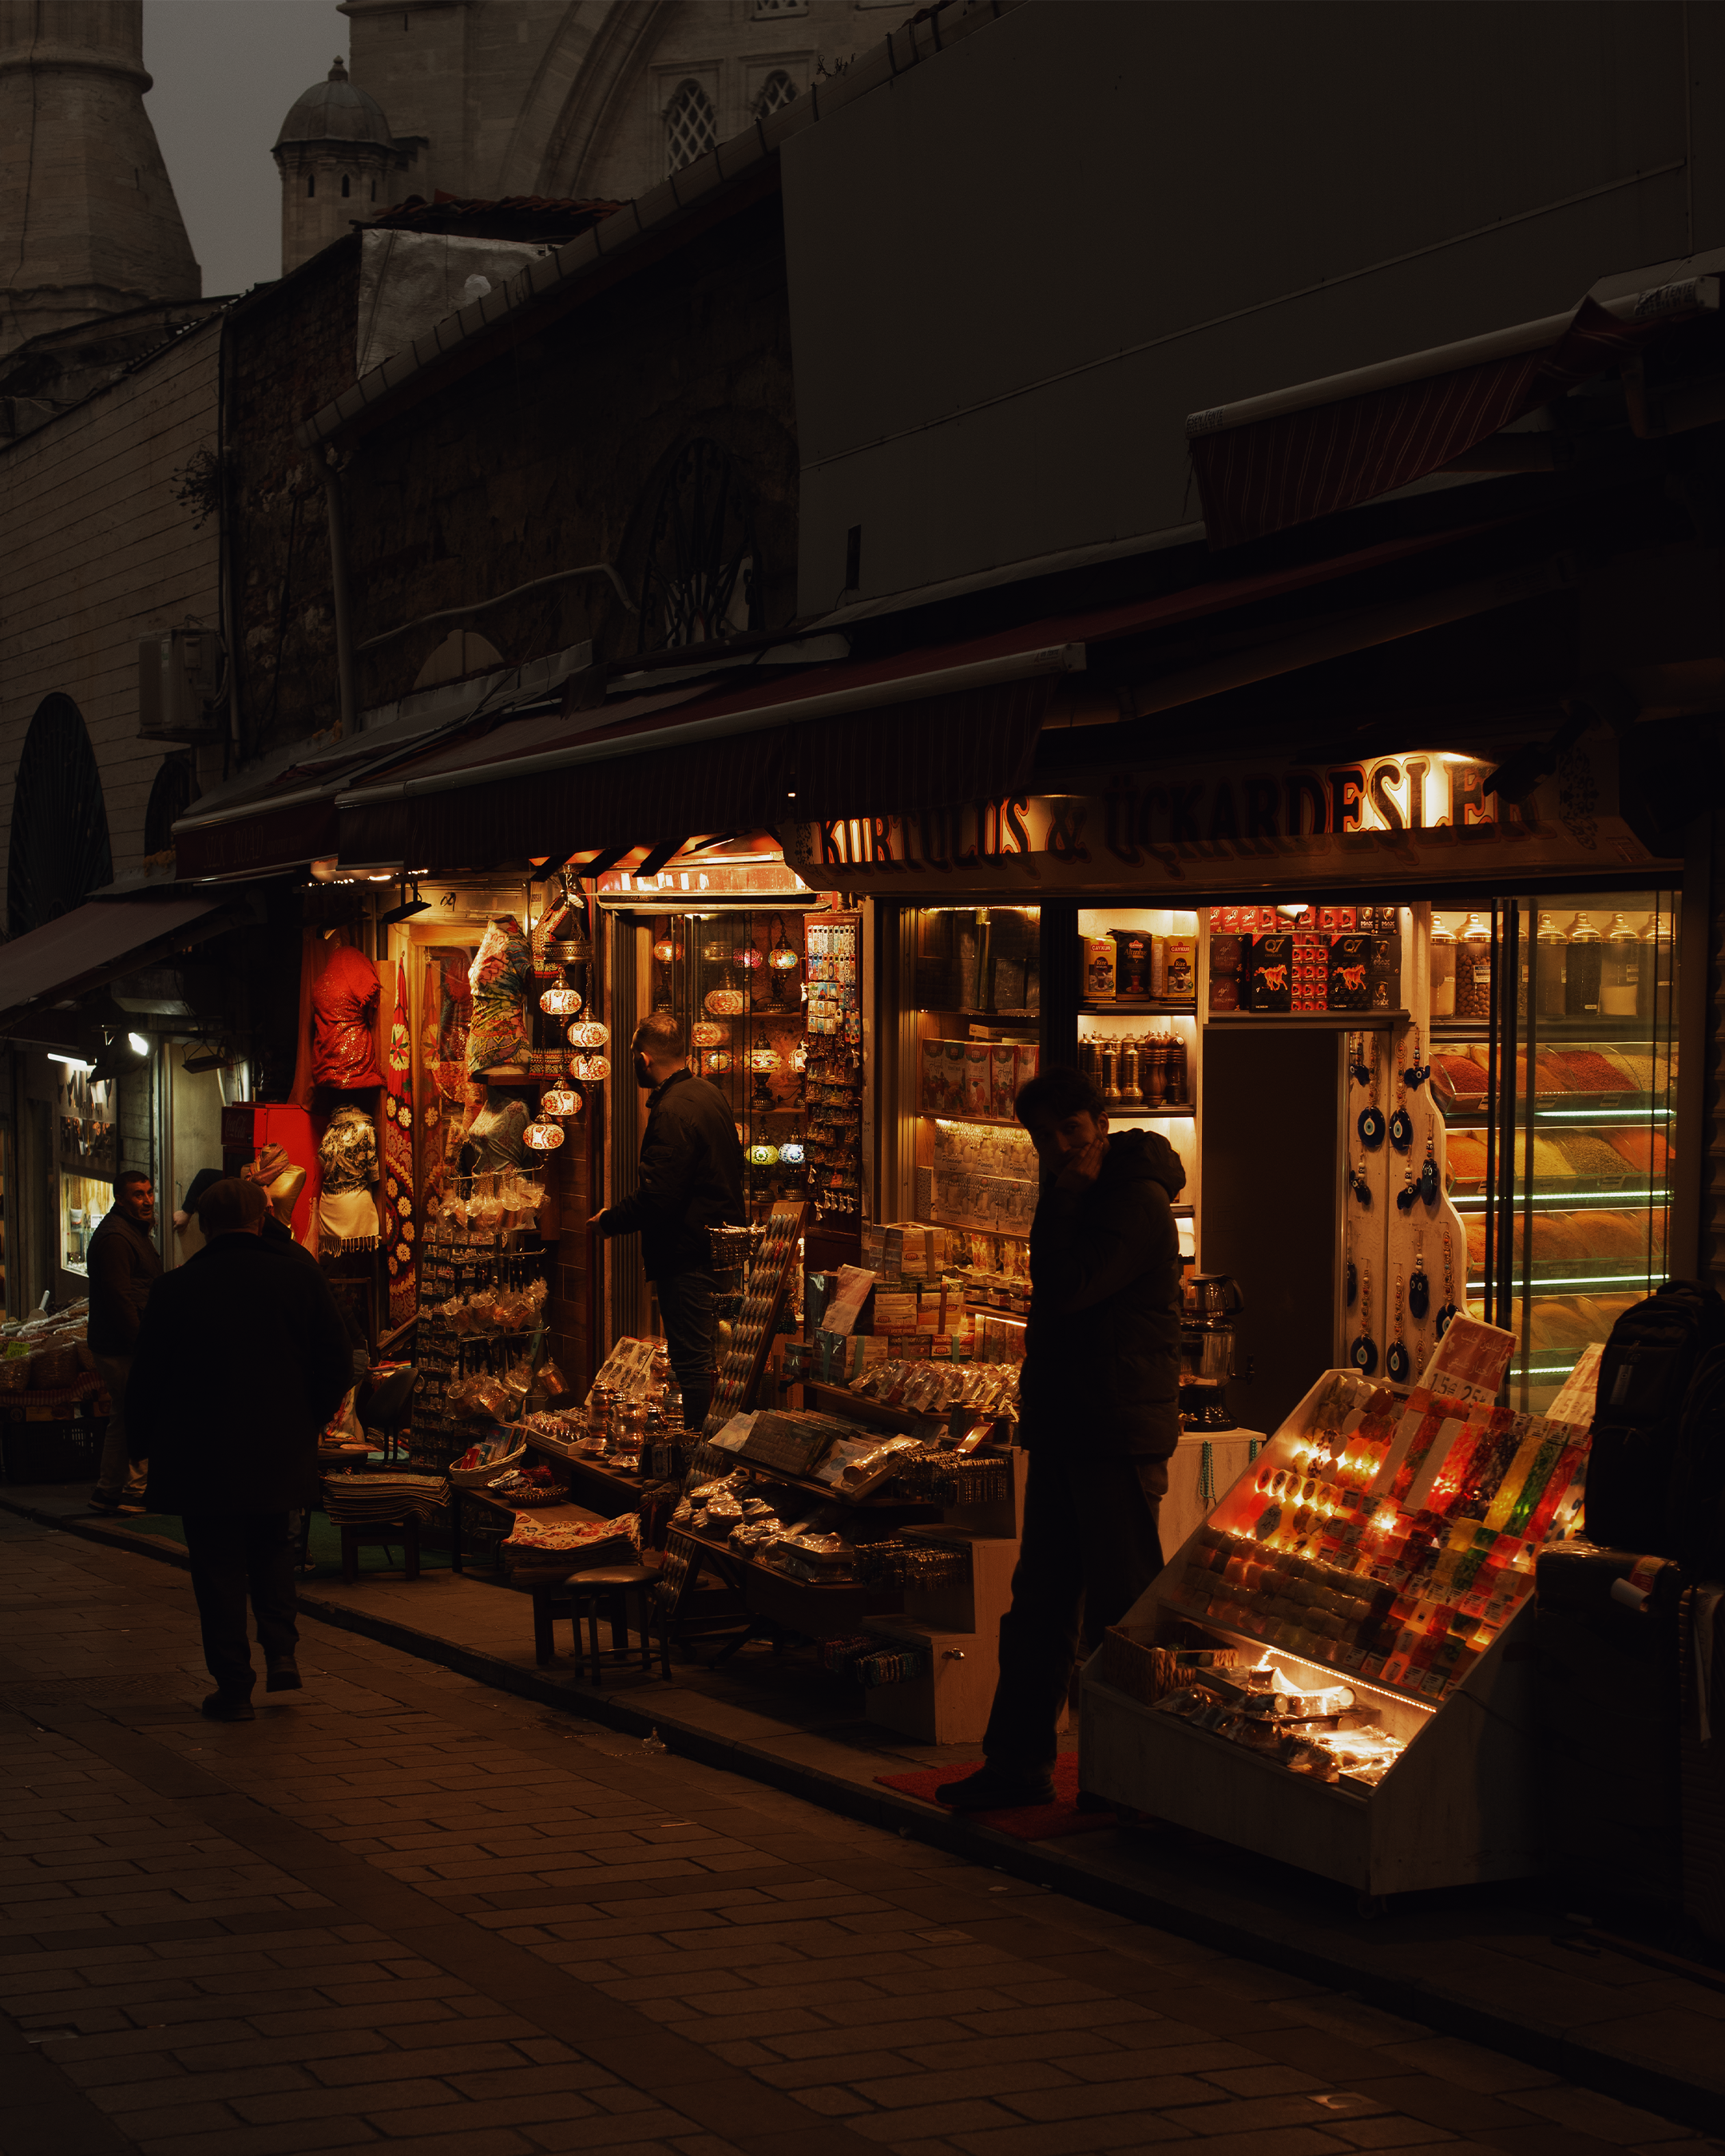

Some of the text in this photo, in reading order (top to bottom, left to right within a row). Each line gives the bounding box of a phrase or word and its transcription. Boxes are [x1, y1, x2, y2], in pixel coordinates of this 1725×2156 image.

[1664, 281, 1693, 299] TENTE
[1187, 409, 1223, 426] ESEN TENTE
[815, 743, 1558, 880] KURTULUŞ & ÜÇKARDEŞLER
[203, 833, 228, 869] SILK
[233, 824, 264, 864] ROAD
[1264, 939, 1285, 953] Q7
[1343, 939, 1364, 954] Q7
